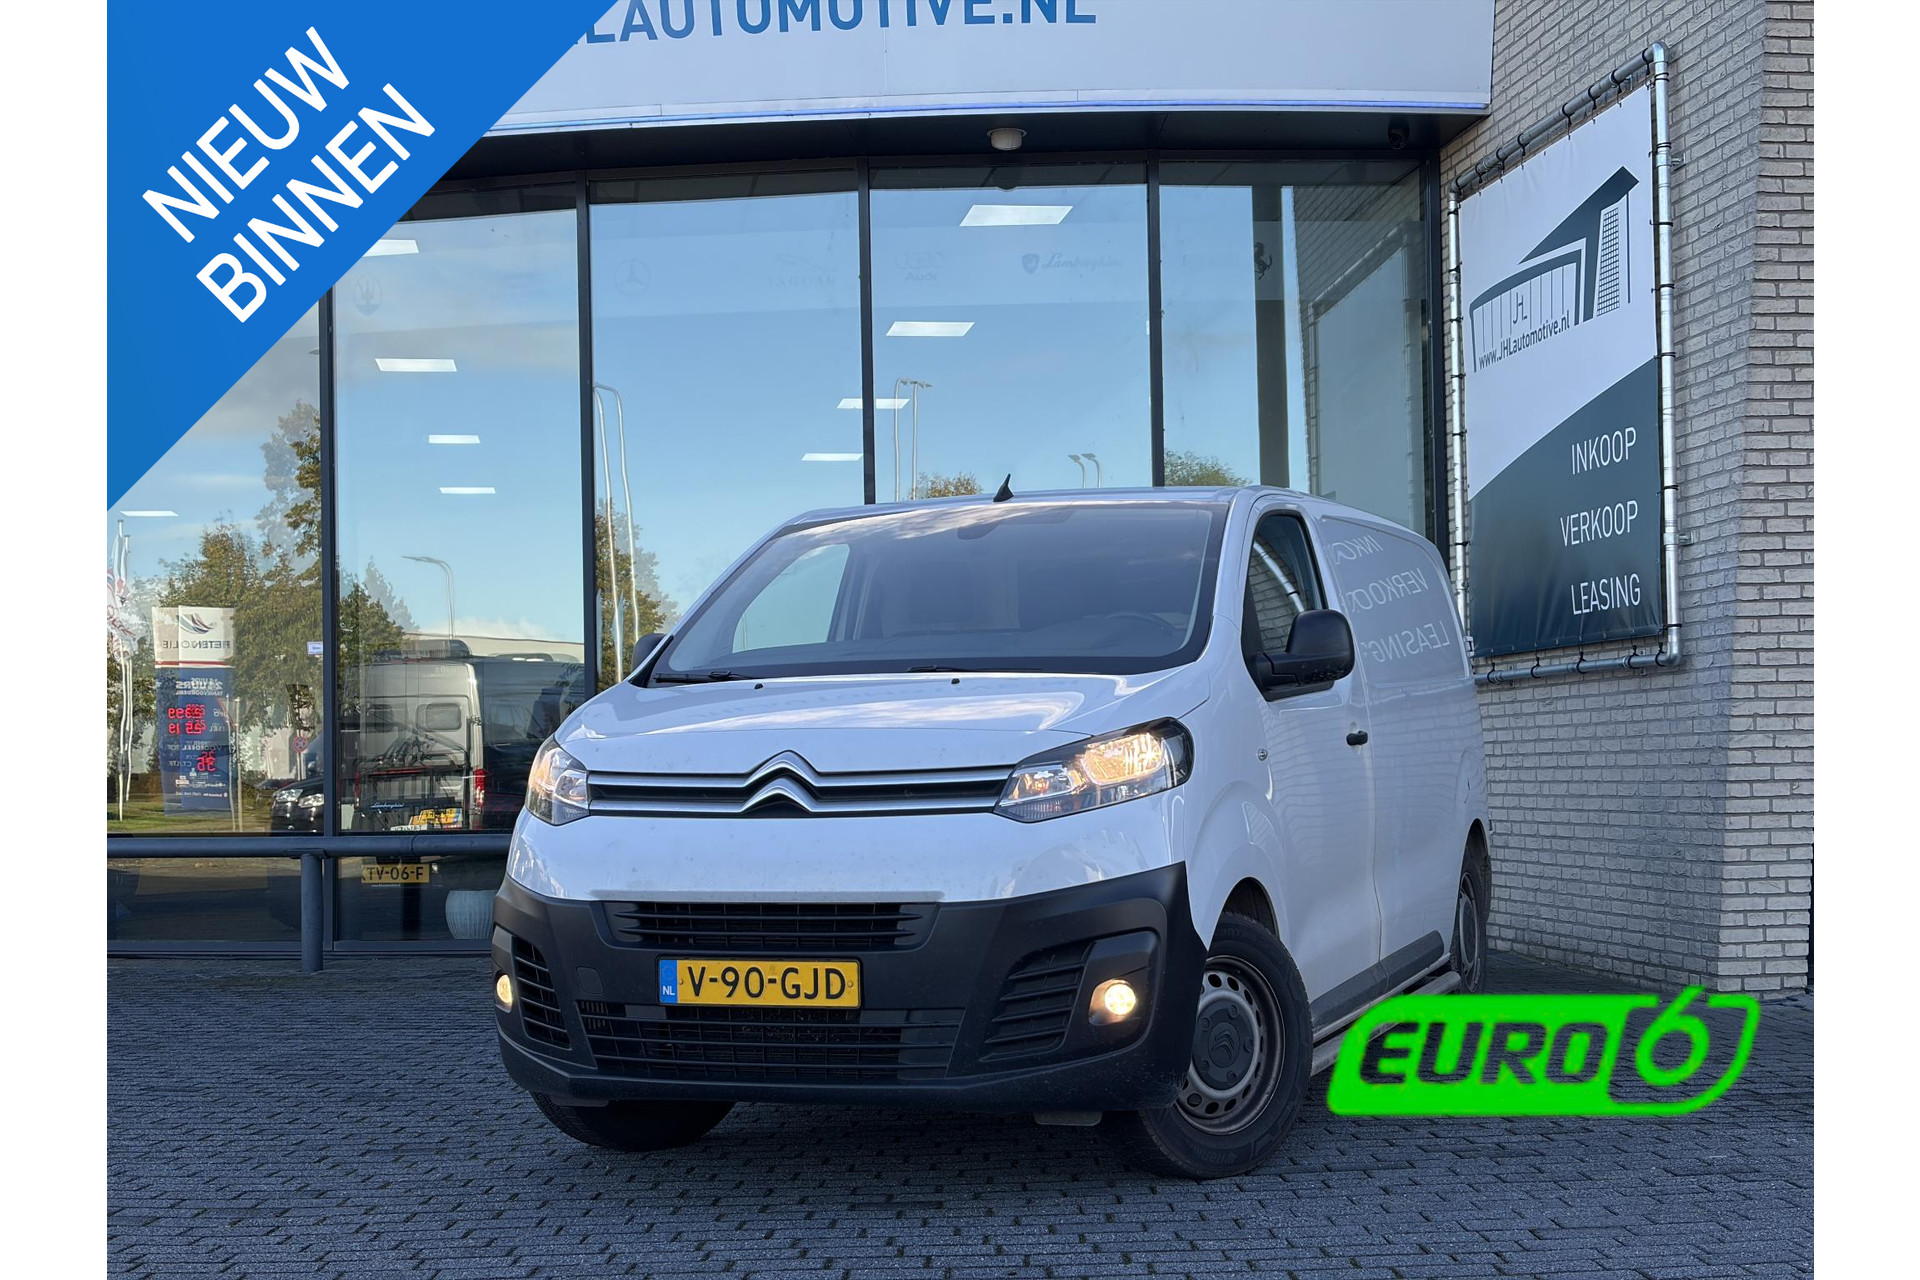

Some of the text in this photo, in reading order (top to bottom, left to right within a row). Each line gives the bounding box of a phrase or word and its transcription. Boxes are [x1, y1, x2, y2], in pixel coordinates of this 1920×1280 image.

[1478, 310, 1570, 370] www.JHLautomotive.nl
[1571, 427, 1636, 475] INKOOP
[1560, 500, 1638, 547] VERKOOP
[1571, 573, 1641, 615] LEASING
[361, 866, 423, 880] TV-06-F
[662, 985, 676, 996] NL
[687, 966, 846, 999] V-90-GJD
